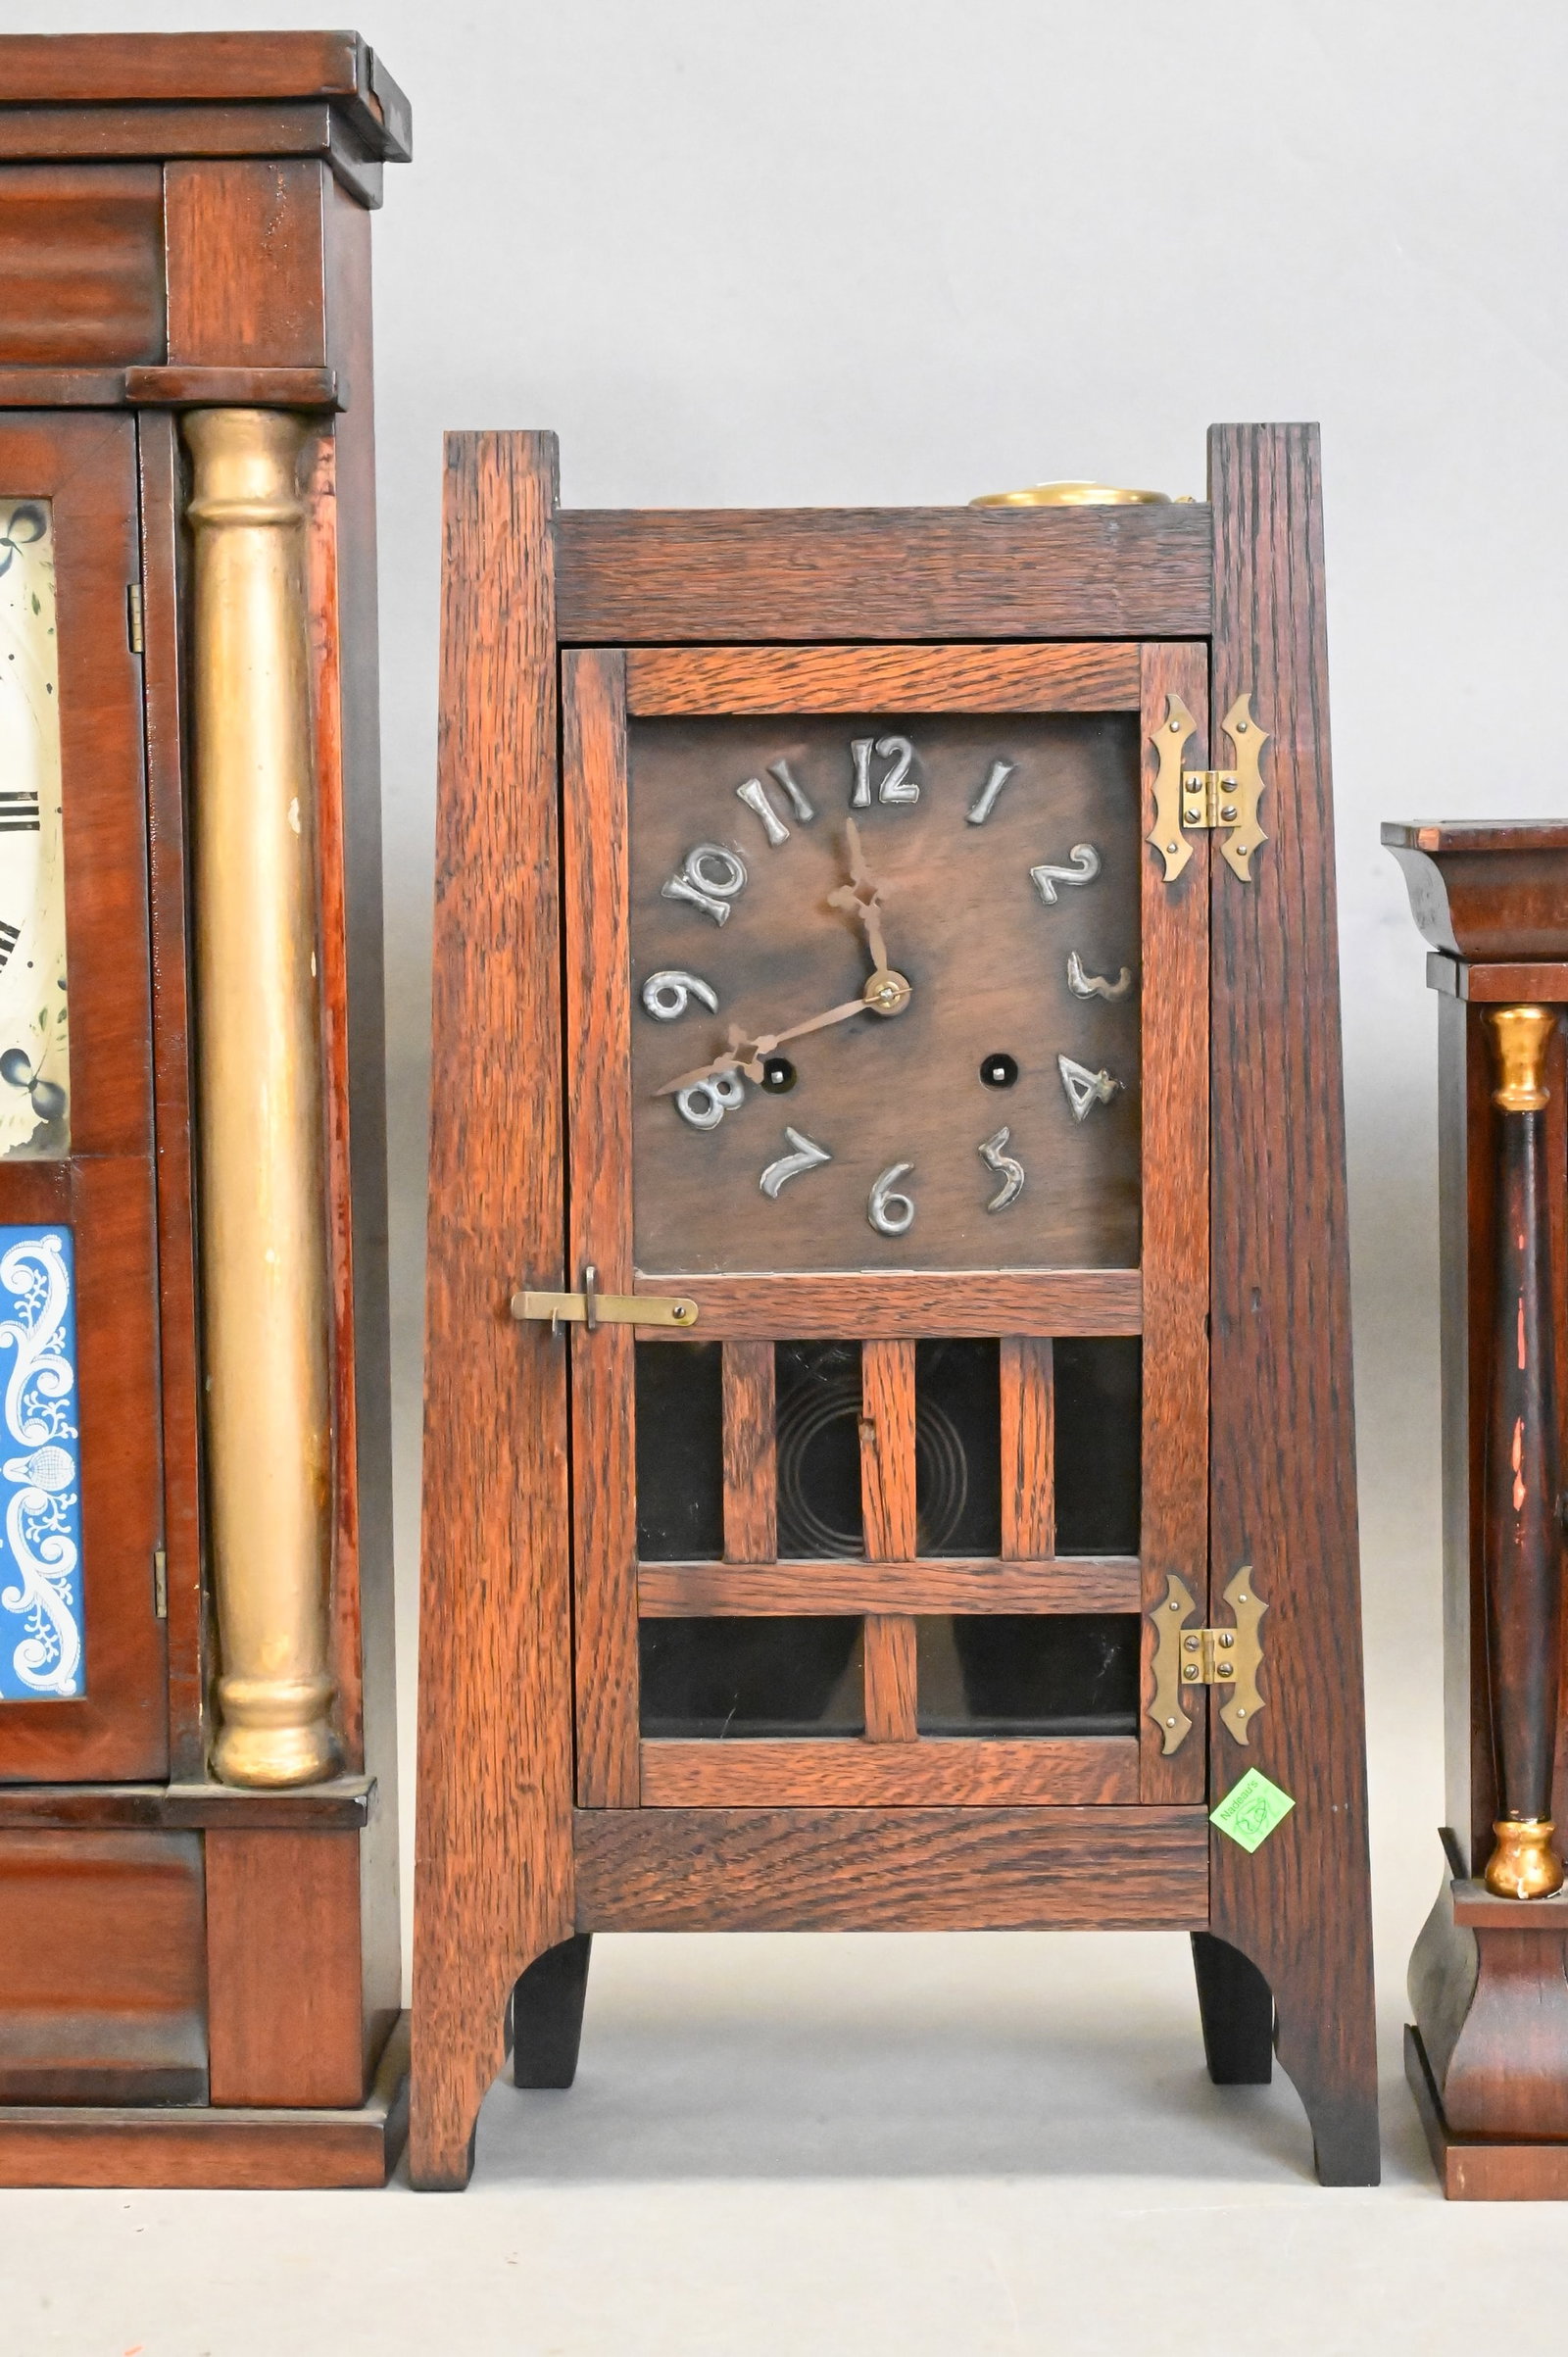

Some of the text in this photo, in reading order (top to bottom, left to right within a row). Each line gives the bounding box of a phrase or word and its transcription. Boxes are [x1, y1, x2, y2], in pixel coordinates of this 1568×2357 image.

[736, 759, 816, 847] 11
[849, 736, 920, 808] 12
[965, 761, 1017, 825] 1
[661, 842, 748, 926] 10
[1030, 843, 1102, 905] 2
[642, 970, 718, 1021] 9
[1067, 951, 1132, 1002] 3
[675, 1069, 746, 1130] 8
[1057, 1054, 1120, 1122] 4
[760, 1126, 832, 1199] 7
[979, 1126, 1025, 1212] 5
[867, 1162, 916, 1236] 6
[1220, 1780, 1258, 1821] Nadeau's
